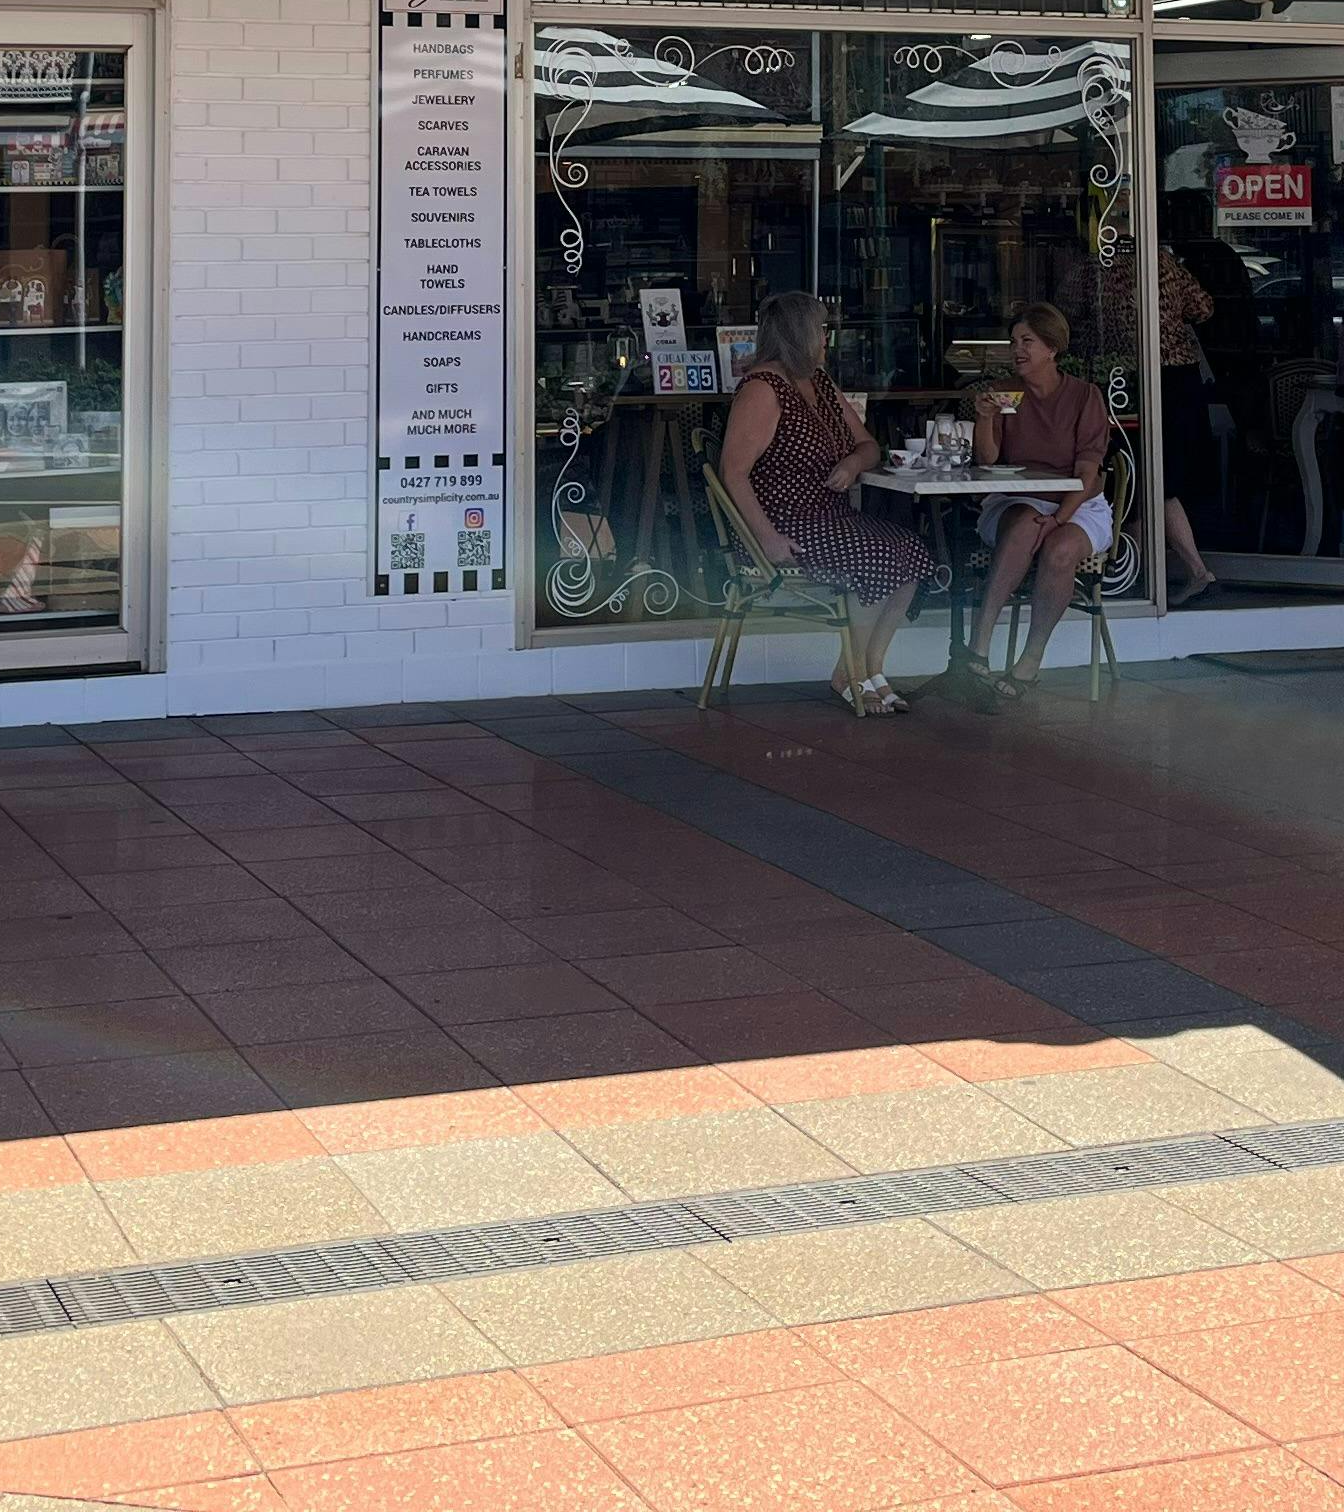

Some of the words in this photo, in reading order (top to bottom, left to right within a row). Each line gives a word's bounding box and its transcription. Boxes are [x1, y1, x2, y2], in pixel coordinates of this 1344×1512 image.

[413, 43, 474, 54] HANDBAGS
[413, 69, 474, 80] PERFUMES
[412, 95, 476, 106] JEWELLERY
[418, 120, 469, 131] SCARVES
[417, 146, 469, 156] CARAVAN
[405, 160, 482, 171] ACCESSORIES
[409, 186, 430, 197] TEA
[433, 186, 478, 197] TOWELS
[1221, 173, 1304, 201] OPEN
[411, 212, 475, 223] SOUVENIRS
[1225, 211, 1261, 221] PLEASE
[1263, 211, 1292, 220] COME
[1294, 211, 1305, 220] IN
[404, 238, 482, 249] TABLECLOTHS
[426, 264, 459, 274] HAND
[420, 278, 465, 289] TOWELS
[383, 304, 501, 316] CANDLES/DIFFUSERS
[402, 330, 482, 342] HANDCREAMS
[423, 356, 461, 368] SOAPS
[659, 368, 712, 388] 2835
[425, 383, 458, 394] GIFTS
[411, 409, 436, 421] AND
[438, 408, 472, 420] MUCH
[406, 424, 442, 436] MUCH
[443, 423, 477, 435] MORE
[400, 476, 431, 489] 0427
[434, 475, 457, 488] 719
[460, 474, 483, 487] 899
[382, 492, 500, 505] countrysimplicity.com.au
